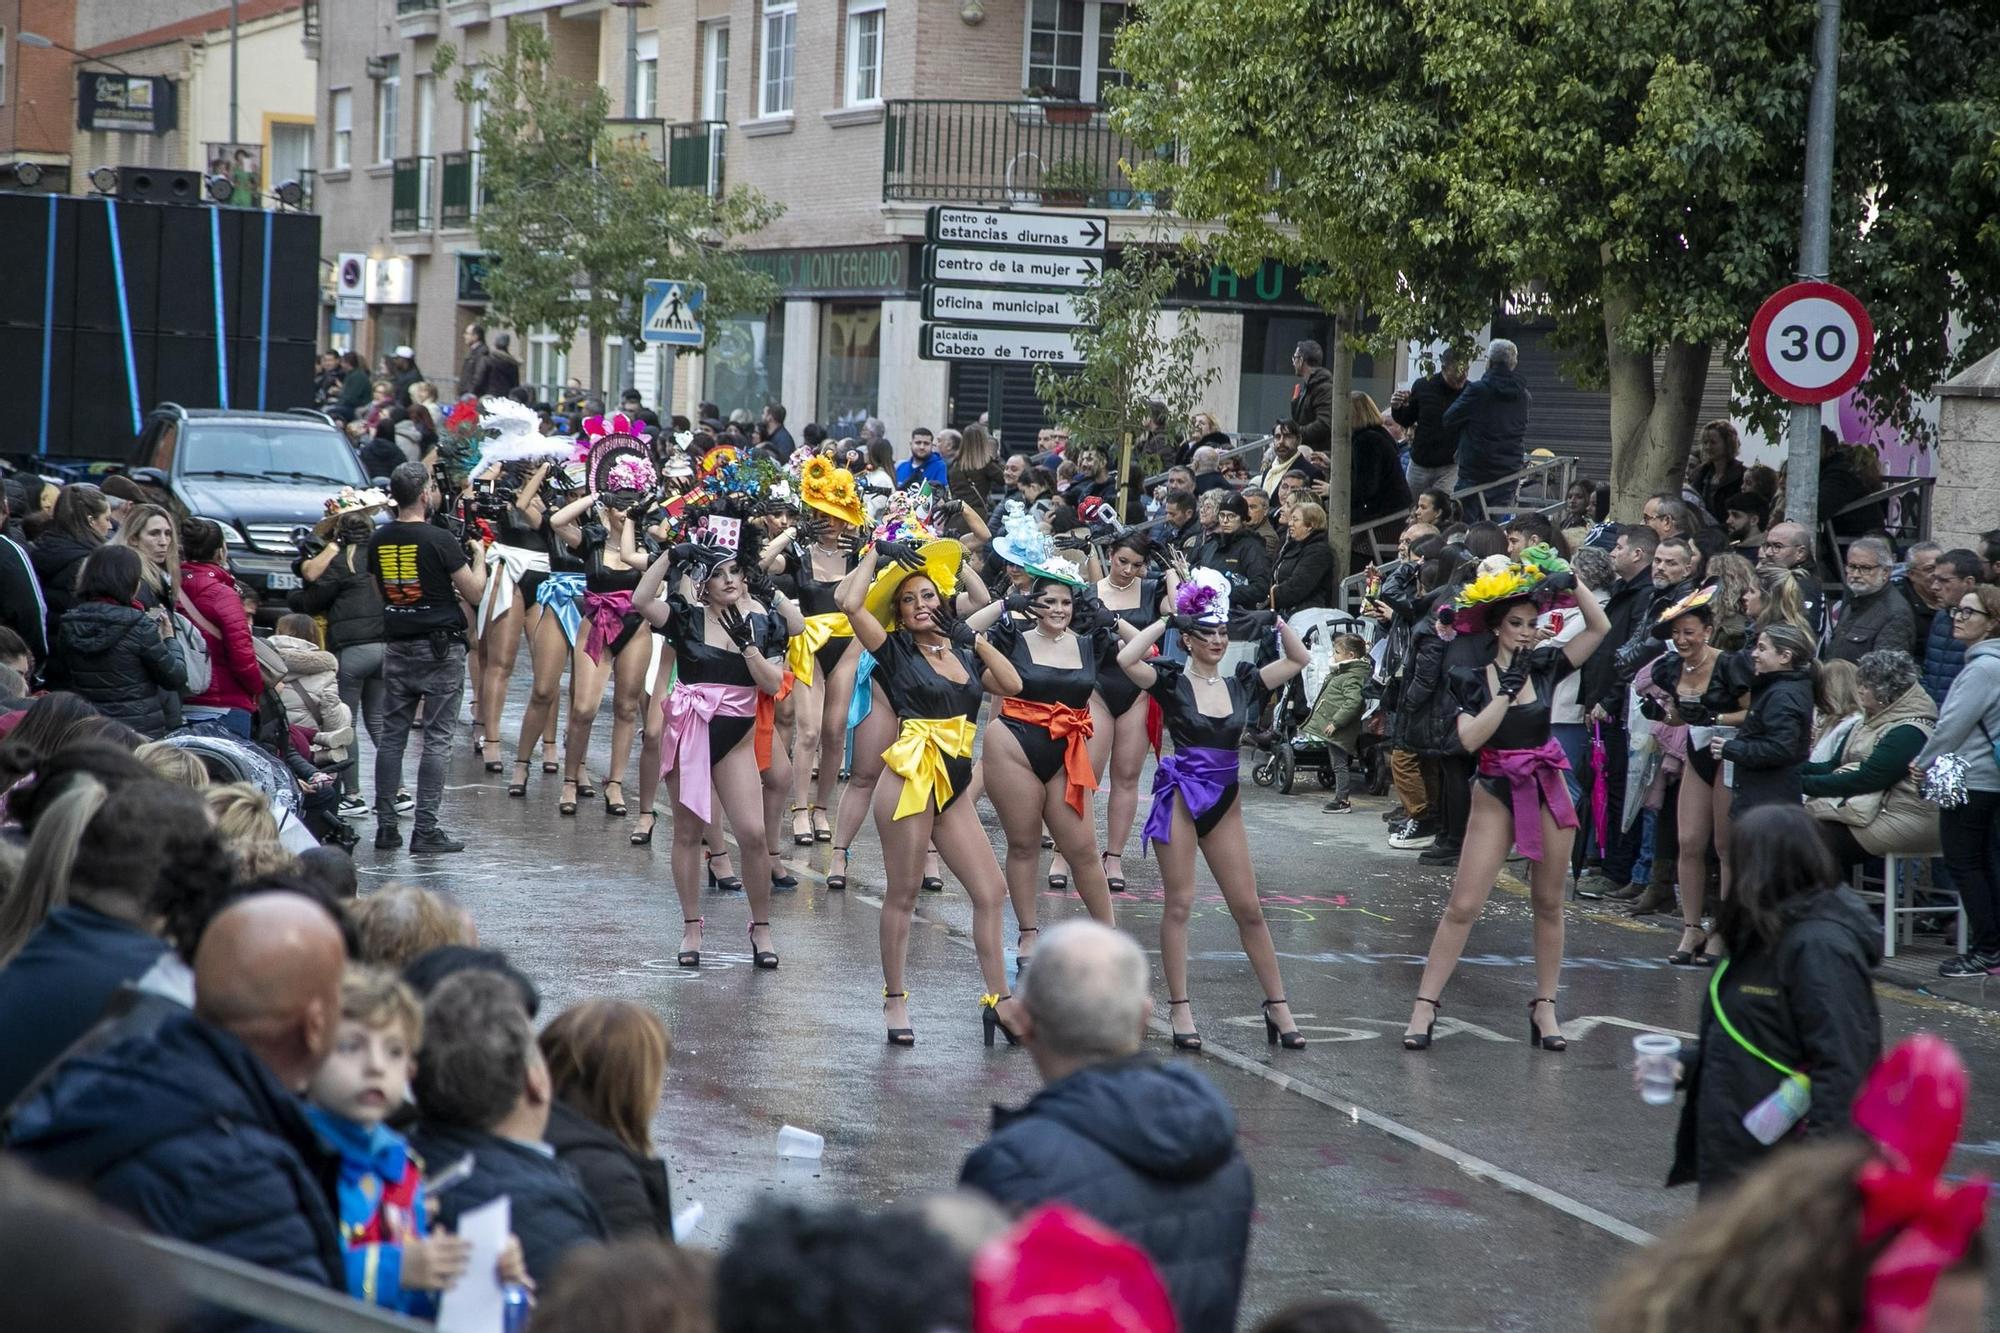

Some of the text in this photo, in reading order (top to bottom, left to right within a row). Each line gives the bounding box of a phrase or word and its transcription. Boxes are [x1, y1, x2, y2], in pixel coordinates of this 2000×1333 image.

[942, 212, 998, 226] centro de
[941, 226, 1069, 245] estancias diurnas
[800, 250, 900, 287] MONTEAGUDO
[938, 258, 1071, 278] centro de la mujer
[936, 296, 1060, 316] oficina municipal
[935, 342, 1064, 360] Cabezo de Torres
[1780, 324, 1847, 362] 30
